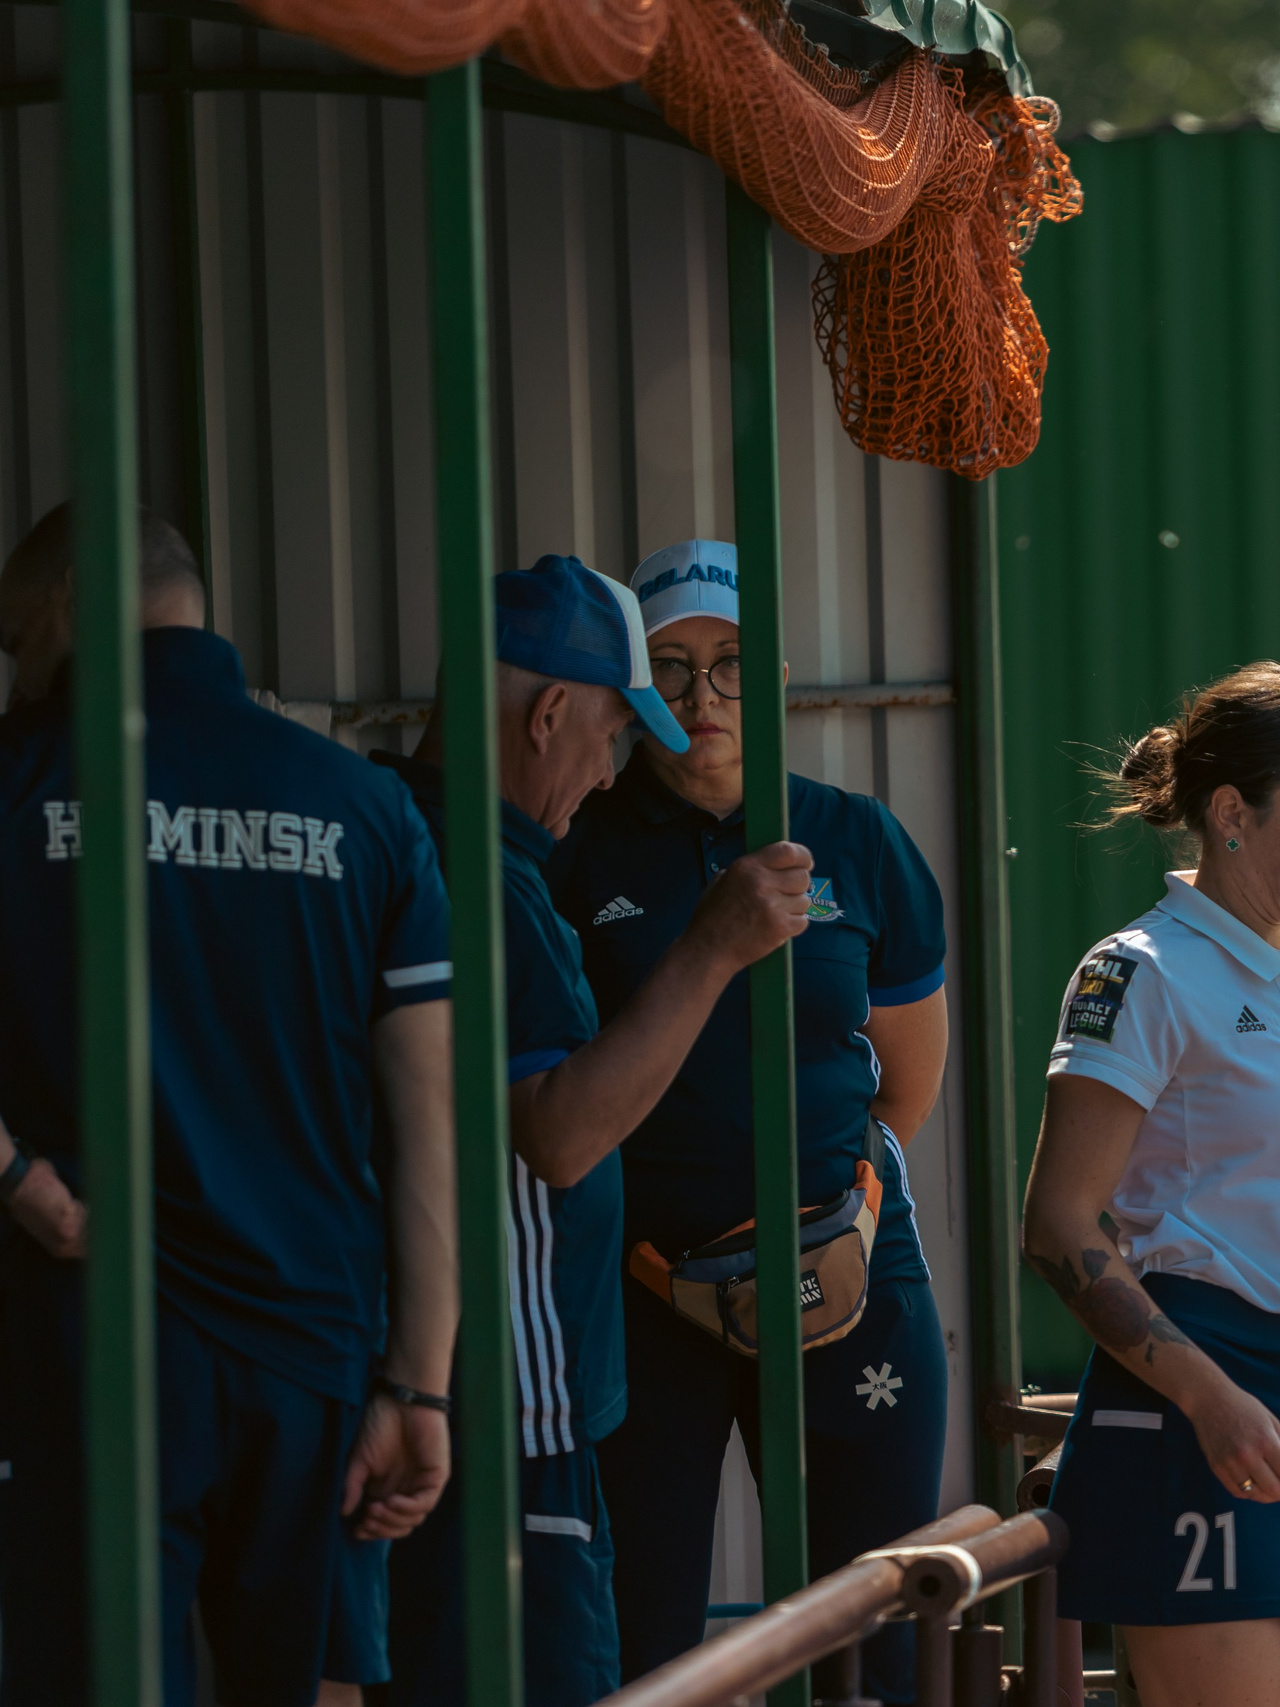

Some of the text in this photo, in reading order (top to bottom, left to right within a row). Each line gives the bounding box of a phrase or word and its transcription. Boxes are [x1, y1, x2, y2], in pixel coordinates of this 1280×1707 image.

[638, 563, 739, 604] BELARU
[146, 799, 344, 880] MINSK
[592, 907, 644, 925] adidas
[1235, 1022, 1267, 1033] adidas
[1174, 1511, 1237, 1592] 21
